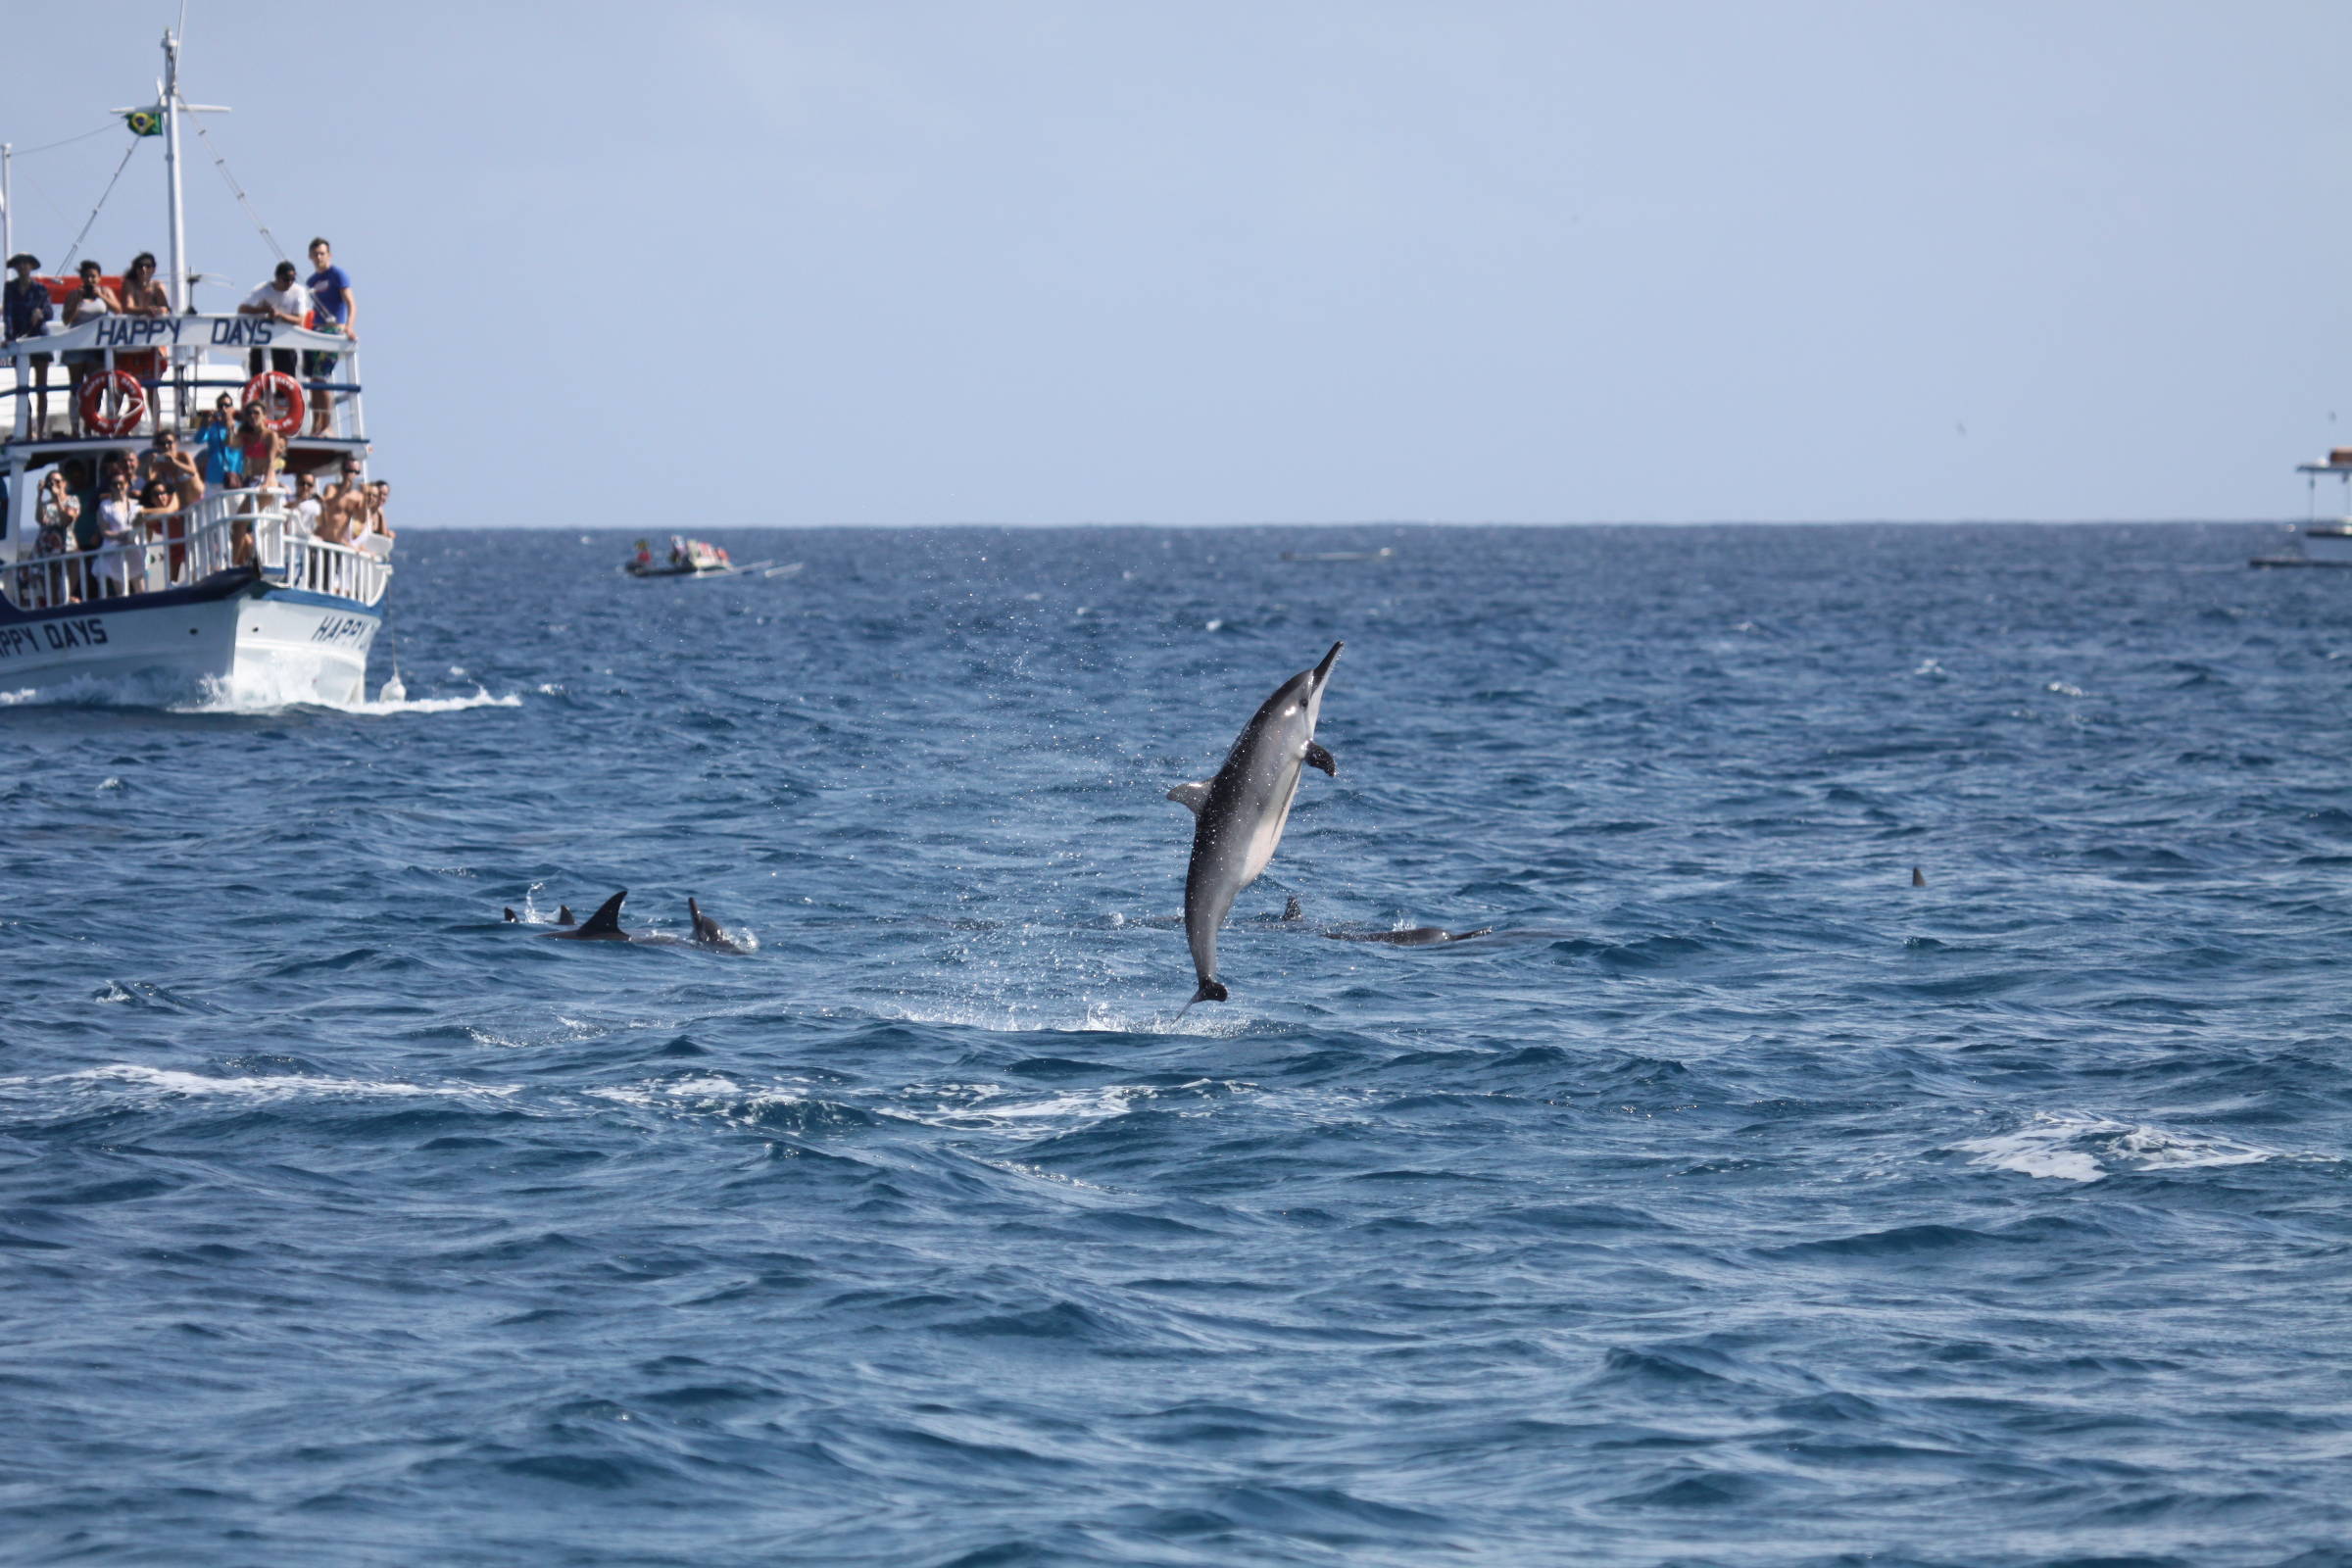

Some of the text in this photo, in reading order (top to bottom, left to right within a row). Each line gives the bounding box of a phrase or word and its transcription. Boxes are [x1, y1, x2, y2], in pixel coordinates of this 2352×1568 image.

[95, 318, 274, 345] HAPPY DAYS
[0, 618, 109, 659] PPY DAYS
